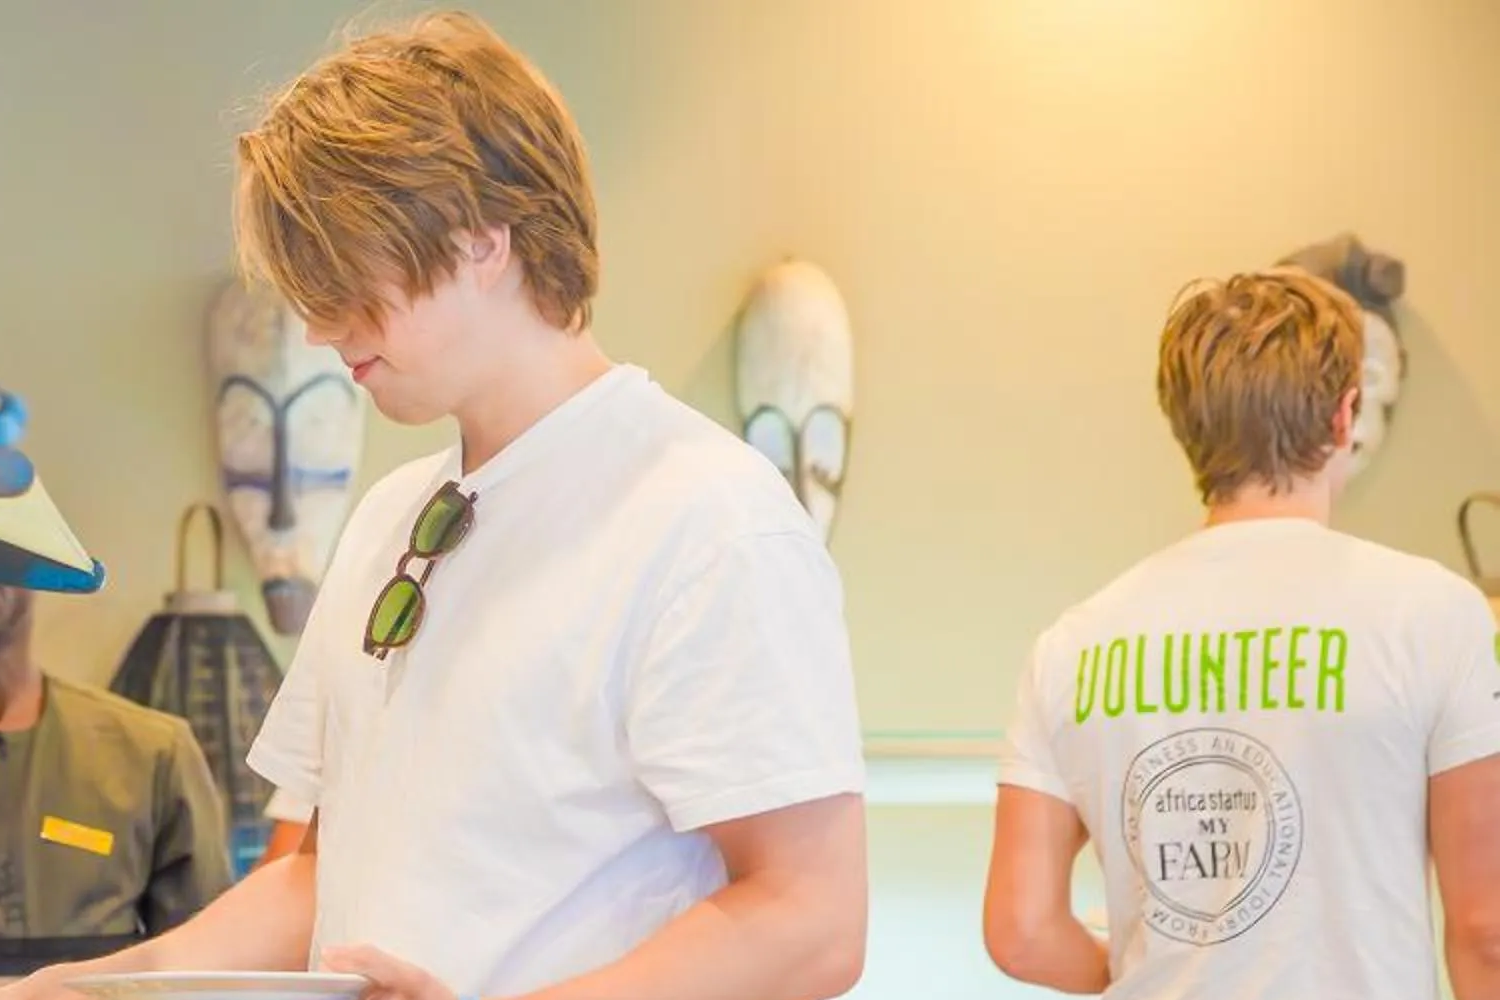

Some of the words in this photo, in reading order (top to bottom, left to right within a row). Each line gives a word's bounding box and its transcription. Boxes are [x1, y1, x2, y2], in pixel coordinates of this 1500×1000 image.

[1074, 626, 1349, 725] VOLUNTEER
[1199, 818, 1230, 834] MY
[1241, 743, 1296, 879] EDUATIONAL
